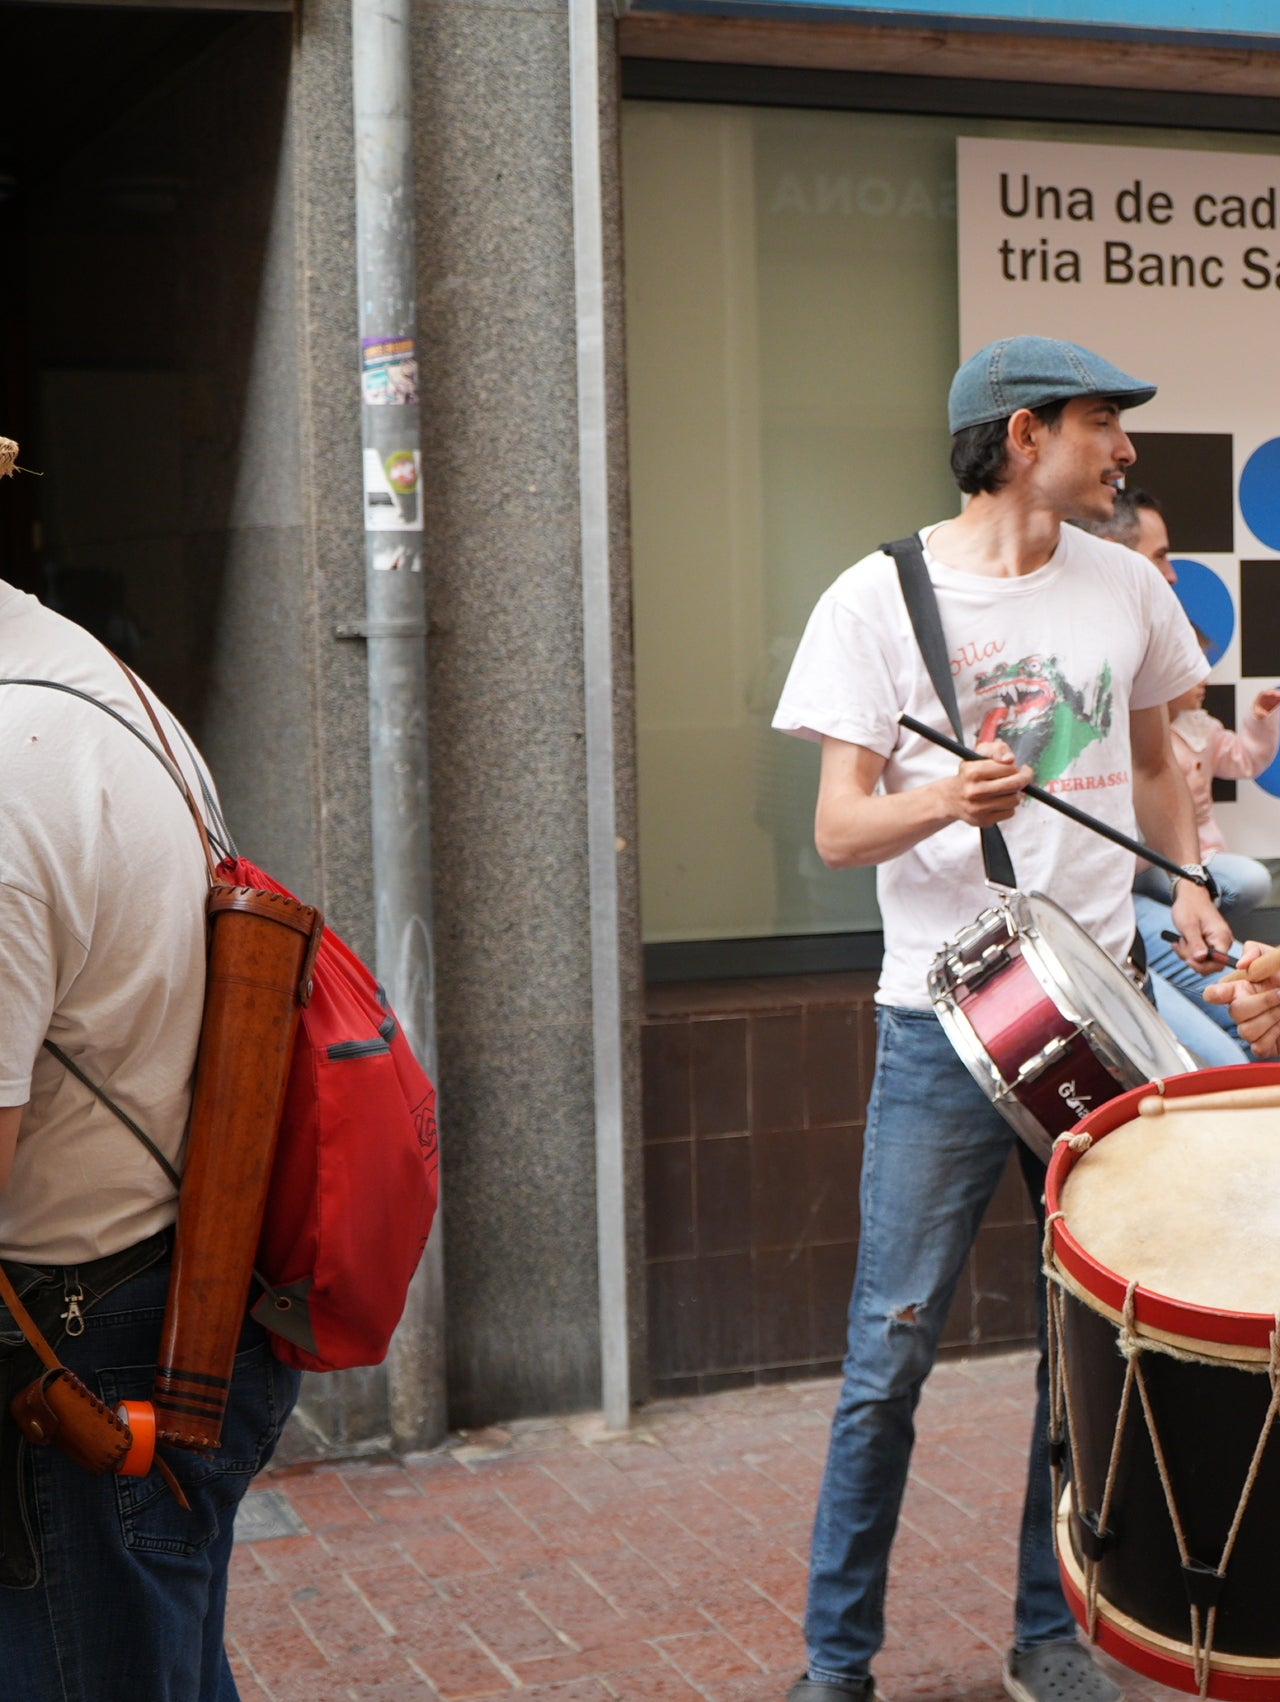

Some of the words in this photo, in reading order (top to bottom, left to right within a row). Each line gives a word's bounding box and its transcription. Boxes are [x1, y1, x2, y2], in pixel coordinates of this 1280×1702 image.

[997, 172, 1095, 223] Una
[1114, 178, 1175, 226] de
[997, 238, 1081, 283] tria
[1104, 240, 1224, 290] Banc
[951, 640, 1007, 677] olla
